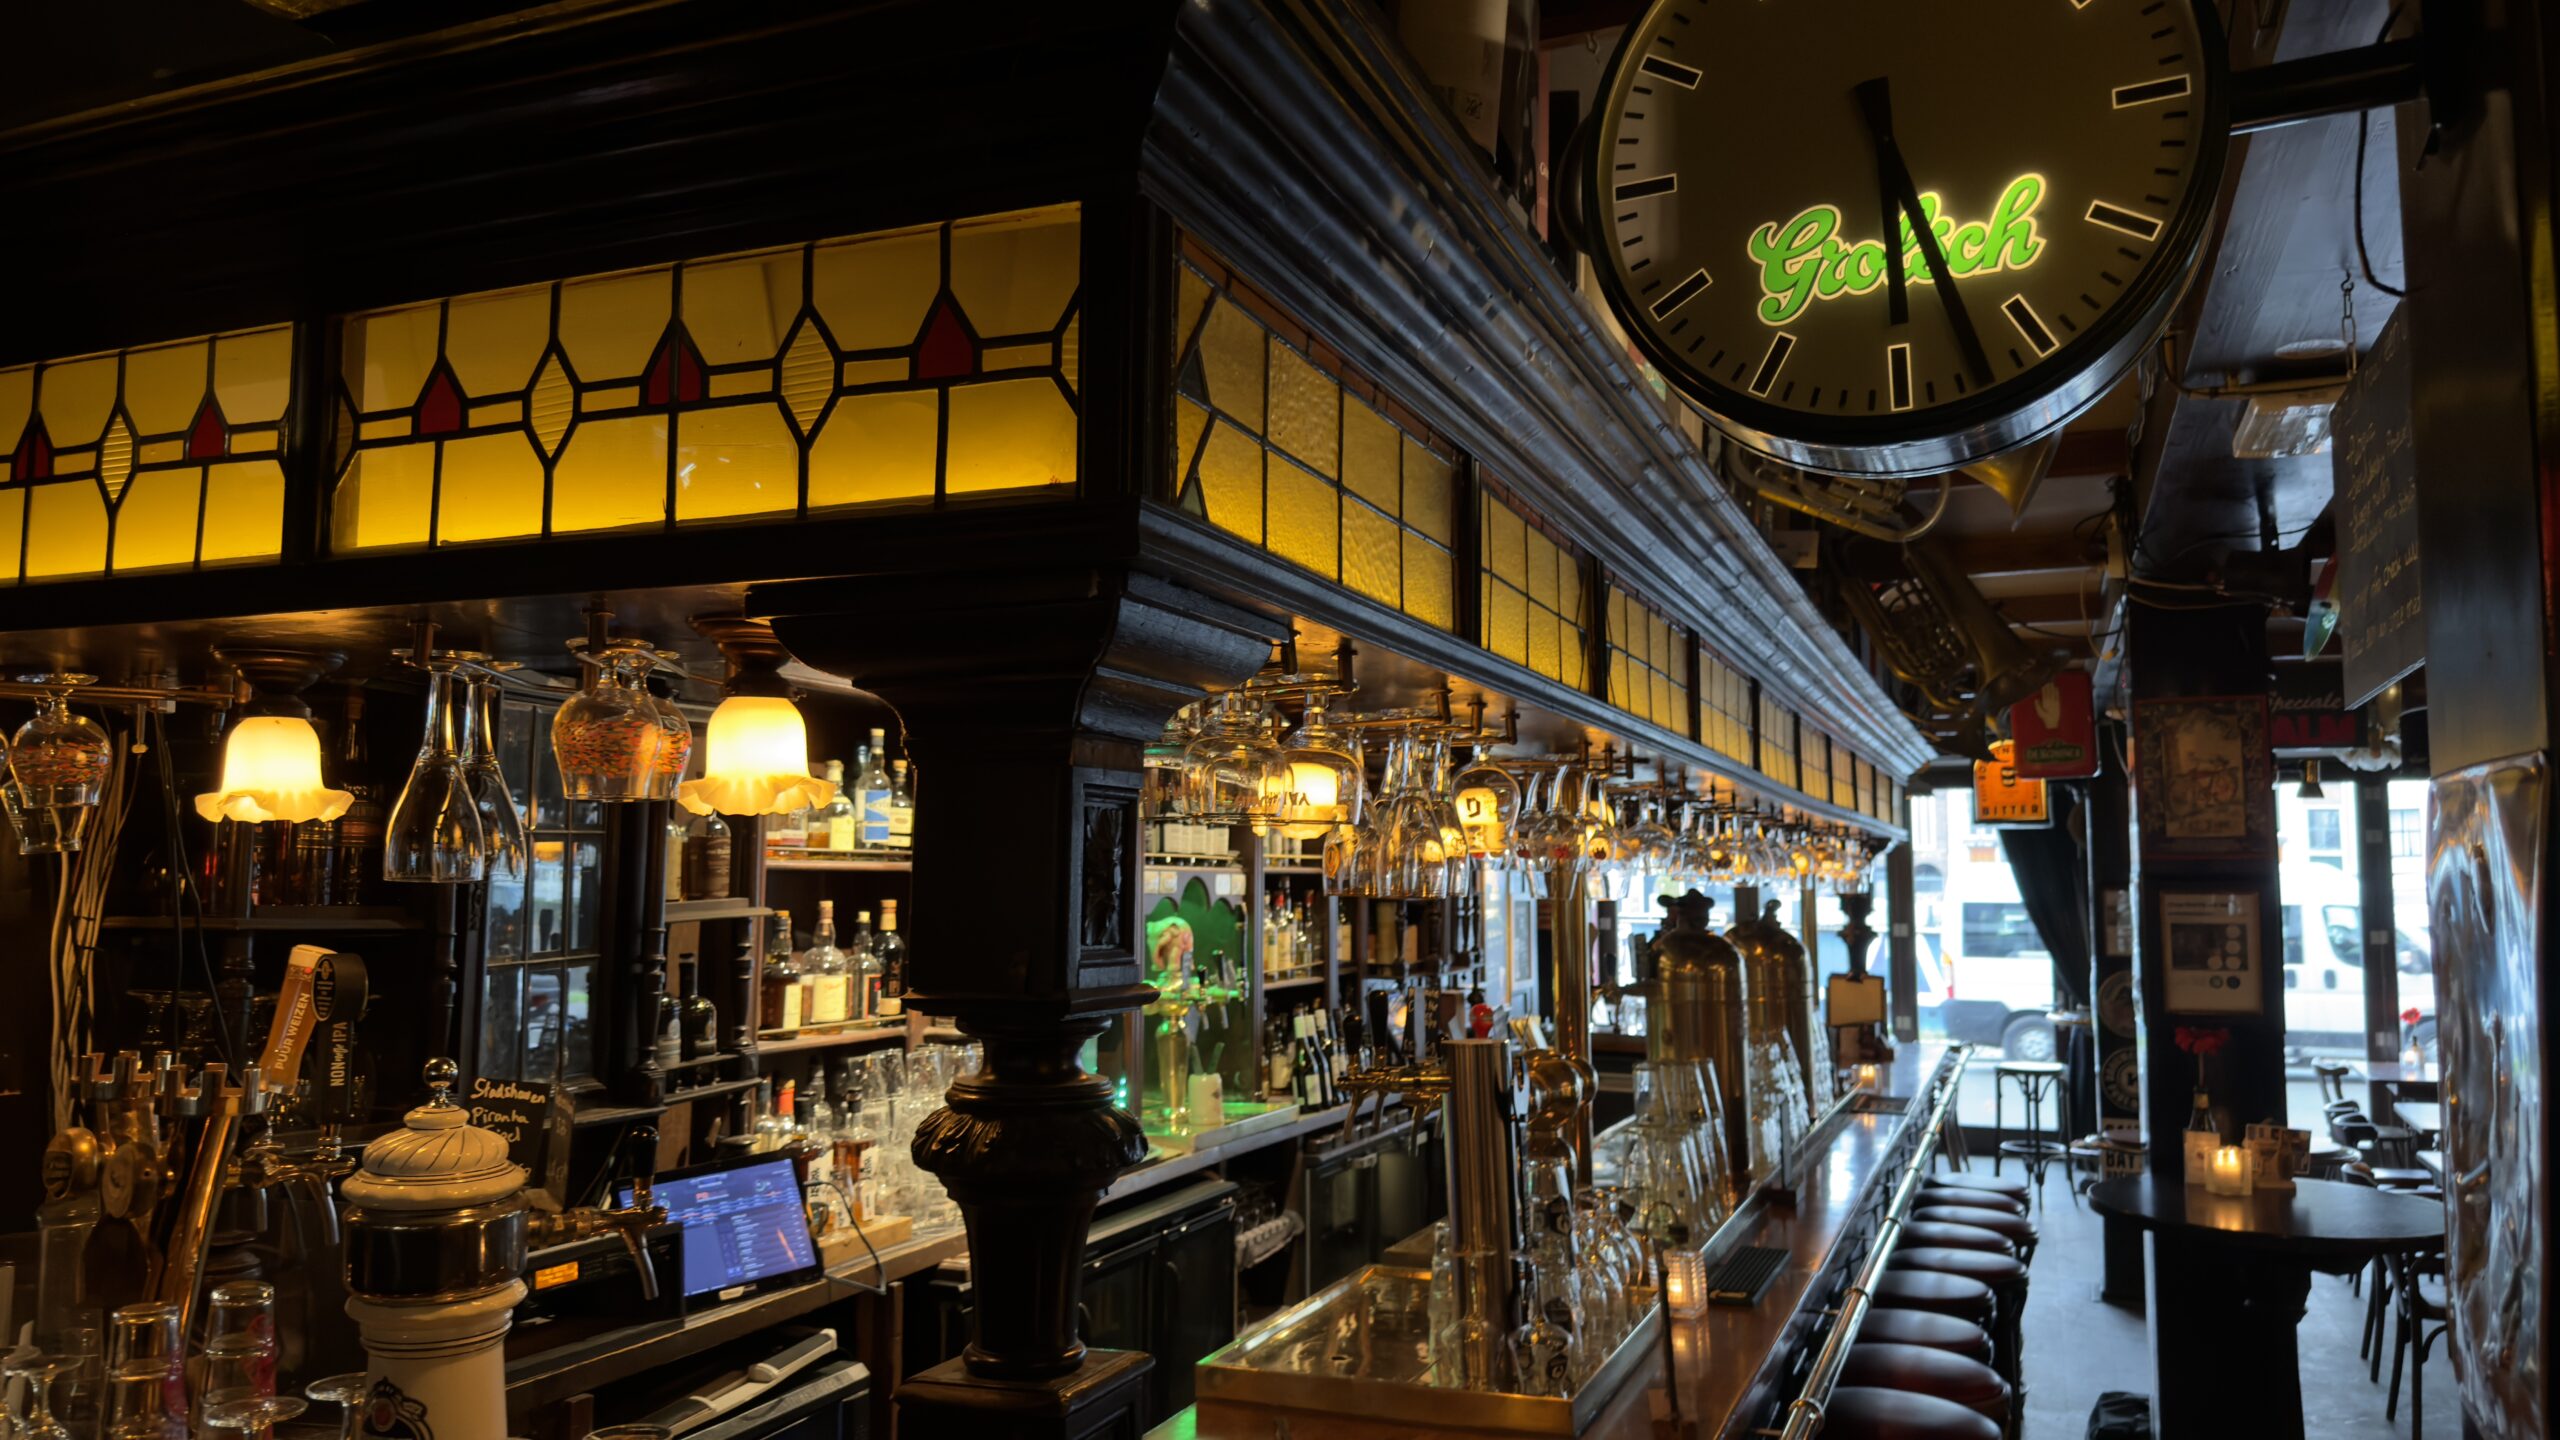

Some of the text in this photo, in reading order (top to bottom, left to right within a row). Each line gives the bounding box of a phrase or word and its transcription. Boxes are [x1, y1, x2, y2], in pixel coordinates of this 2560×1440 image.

[1748, 173, 2047, 326] Grolsch
[2271, 713, 2356, 745] ALM
[1982, 803, 2039, 816] BITTER
[275, 1030, 297, 1070] PUUR
[287, 992, 311, 1034] WEIZEN
[332, 1021, 349, 1043] IPA
[472, 1106, 530, 1125] Piranha
